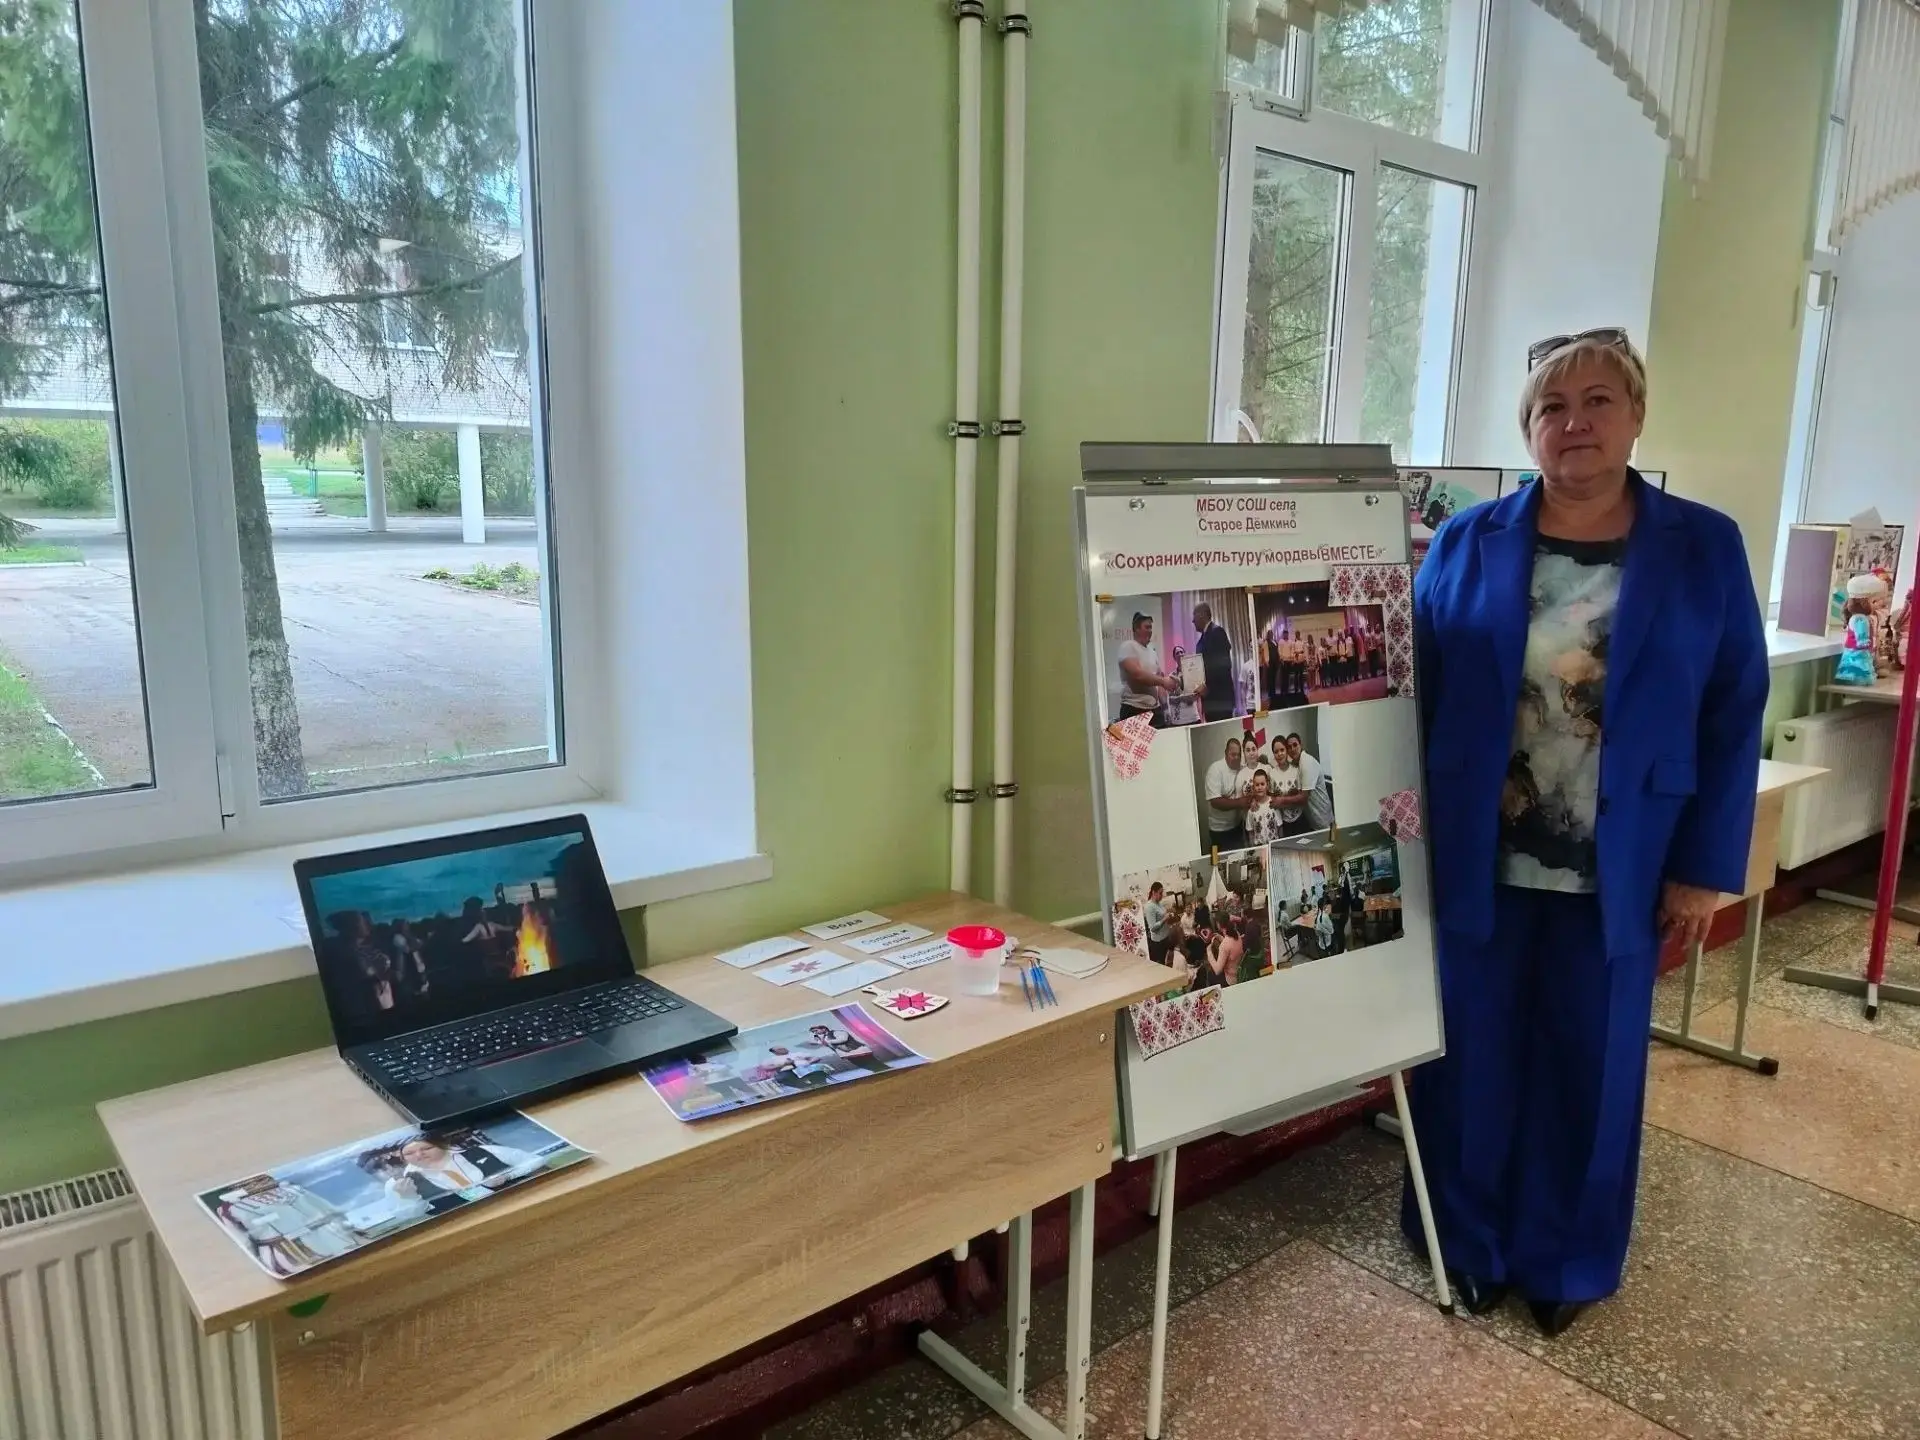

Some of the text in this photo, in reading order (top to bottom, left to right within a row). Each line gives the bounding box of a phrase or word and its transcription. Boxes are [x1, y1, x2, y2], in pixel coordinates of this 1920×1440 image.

[1196, 498, 1297, 512] МБОУ СОШ села
[1198, 517, 1297, 533] Старое Дёмкино
[1106, 553, 1194, 571] «Сохраним
[1196, 550, 1264, 566] культуру
[1264, 549, 1320, 566] мордвы
